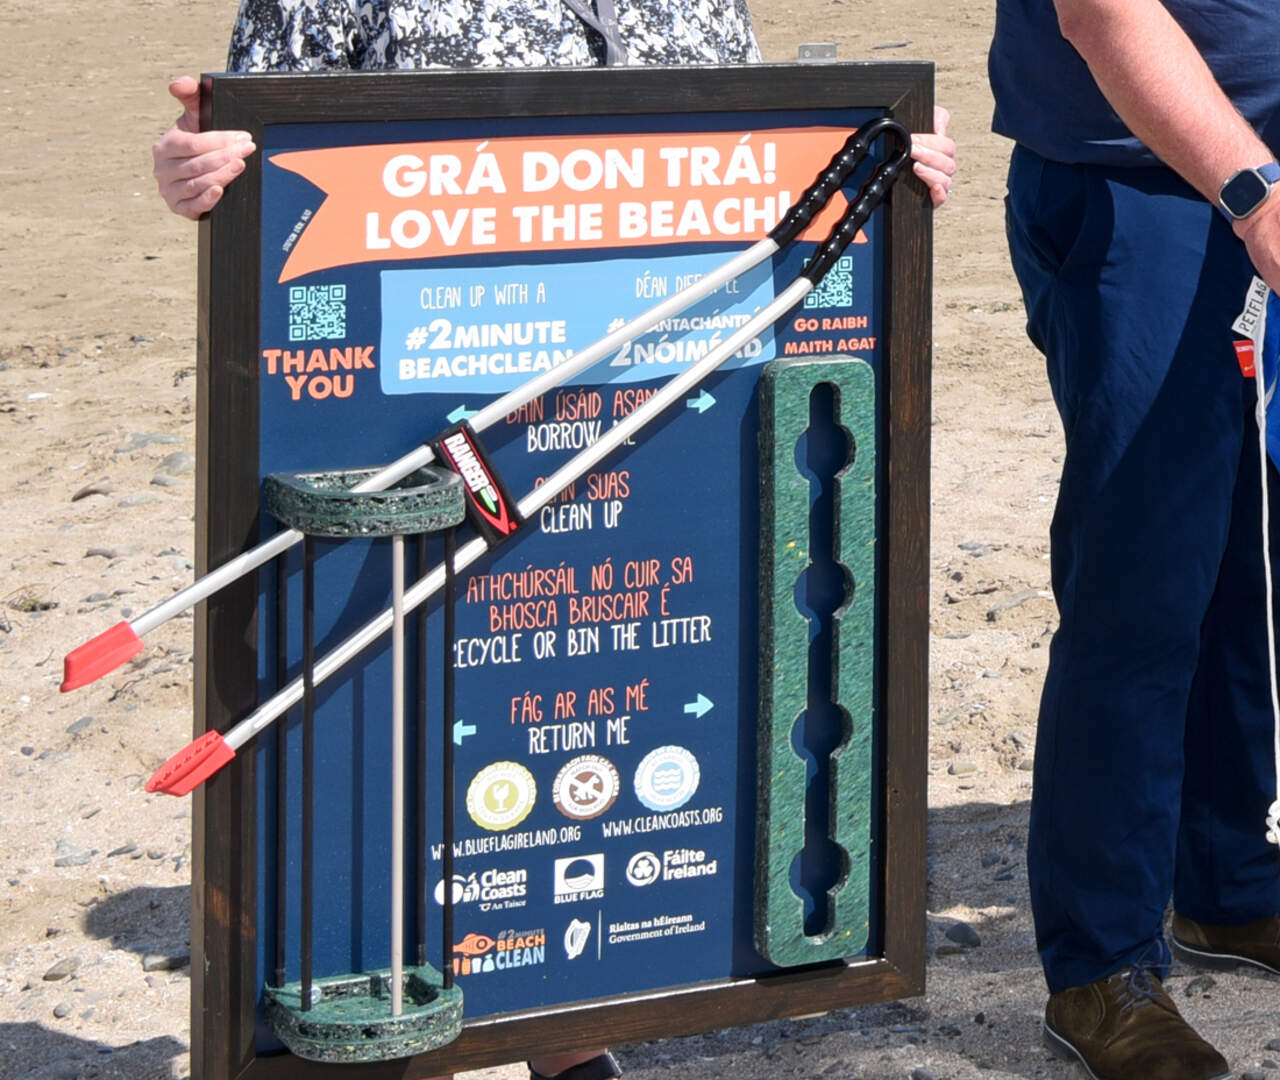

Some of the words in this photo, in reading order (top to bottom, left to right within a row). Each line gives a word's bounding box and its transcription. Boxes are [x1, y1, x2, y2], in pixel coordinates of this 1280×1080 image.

[382, 141, 507, 197] GRÁ
[522, 148, 644, 192] DON
[659, 133, 776, 187] TRÁ!
[365, 207, 496, 249] LOVE
[512, 203, 603, 242] THE
[618, 190, 790, 238] BEACH!
[420, 286, 462, 309] CLEAN
[470, 285, 485, 307] UP
[494, 283, 529, 305] WITH
[536, 282, 546, 304] A
[636, 270, 668, 298] DÉAN
[405, 318, 567, 351] #2MINUTE
[794, 317, 819, 332] GO
[822, 316, 868, 330] RAIBH
[263, 345, 375, 374] THANK
[784, 340, 833, 354] MAITH
[836, 337, 876, 351] AGAT
[399, 349, 574, 380] BEACHCLEAN
[285, 374, 354, 400] YOU
[555, 387, 602, 421] ÚSÁID
[527, 420, 602, 453] BORROW
[444, 432, 489, 492] RANGER
[587, 470, 630, 500] SUAS
[541, 503, 592, 533] CLEAN
[604, 500, 623, 528] UP
[466, 561, 579, 604] ATHCHÚRSÁIL
[591, 557, 613, 592] NÓ
[624, 559, 660, 589] CUIR
[671, 556, 693, 585] SA
[489, 600, 558, 632] BHOSCA
[569, 591, 649, 625] BRUSCAIR
[661, 582, 671, 616] É
[453, 633, 522, 668] ECYCLE
[533, 631, 557, 660] OR
[567, 627, 599, 657] BIN
[610, 622, 641, 651] THE
[652, 615, 712, 648] LITTER
[511, 690, 543, 725] FÁG
[554, 691, 576, 720] AR
[588, 687, 615, 716] AIS
[625, 678, 650, 712] MÉ
[528, 721, 596, 754] RETURN
[607, 716, 631, 745] ME
[602, 807, 723, 838] WWW.CLEANCOASTS.ORG
[431, 825, 581, 861] WW.BLUEFLAGIRELAND.ORG
[663, 848, 705, 866] Fáilte
[481, 868, 527, 887] Clean
[663, 860, 717, 881] Ireland
[481, 884, 526, 900] Coasts
[554, 893, 578, 904] BLUE
[580, 890, 605, 901] FLAG
[609, 921, 640, 933] Rialtas
[641, 920, 652, 928] na
[609, 930, 662, 944] Government
[664, 925, 676, 936] of
[675, 921, 705, 935] Ireland
[497, 934, 545, 951] BEACH
[496, 946, 545, 970] CLEAN
